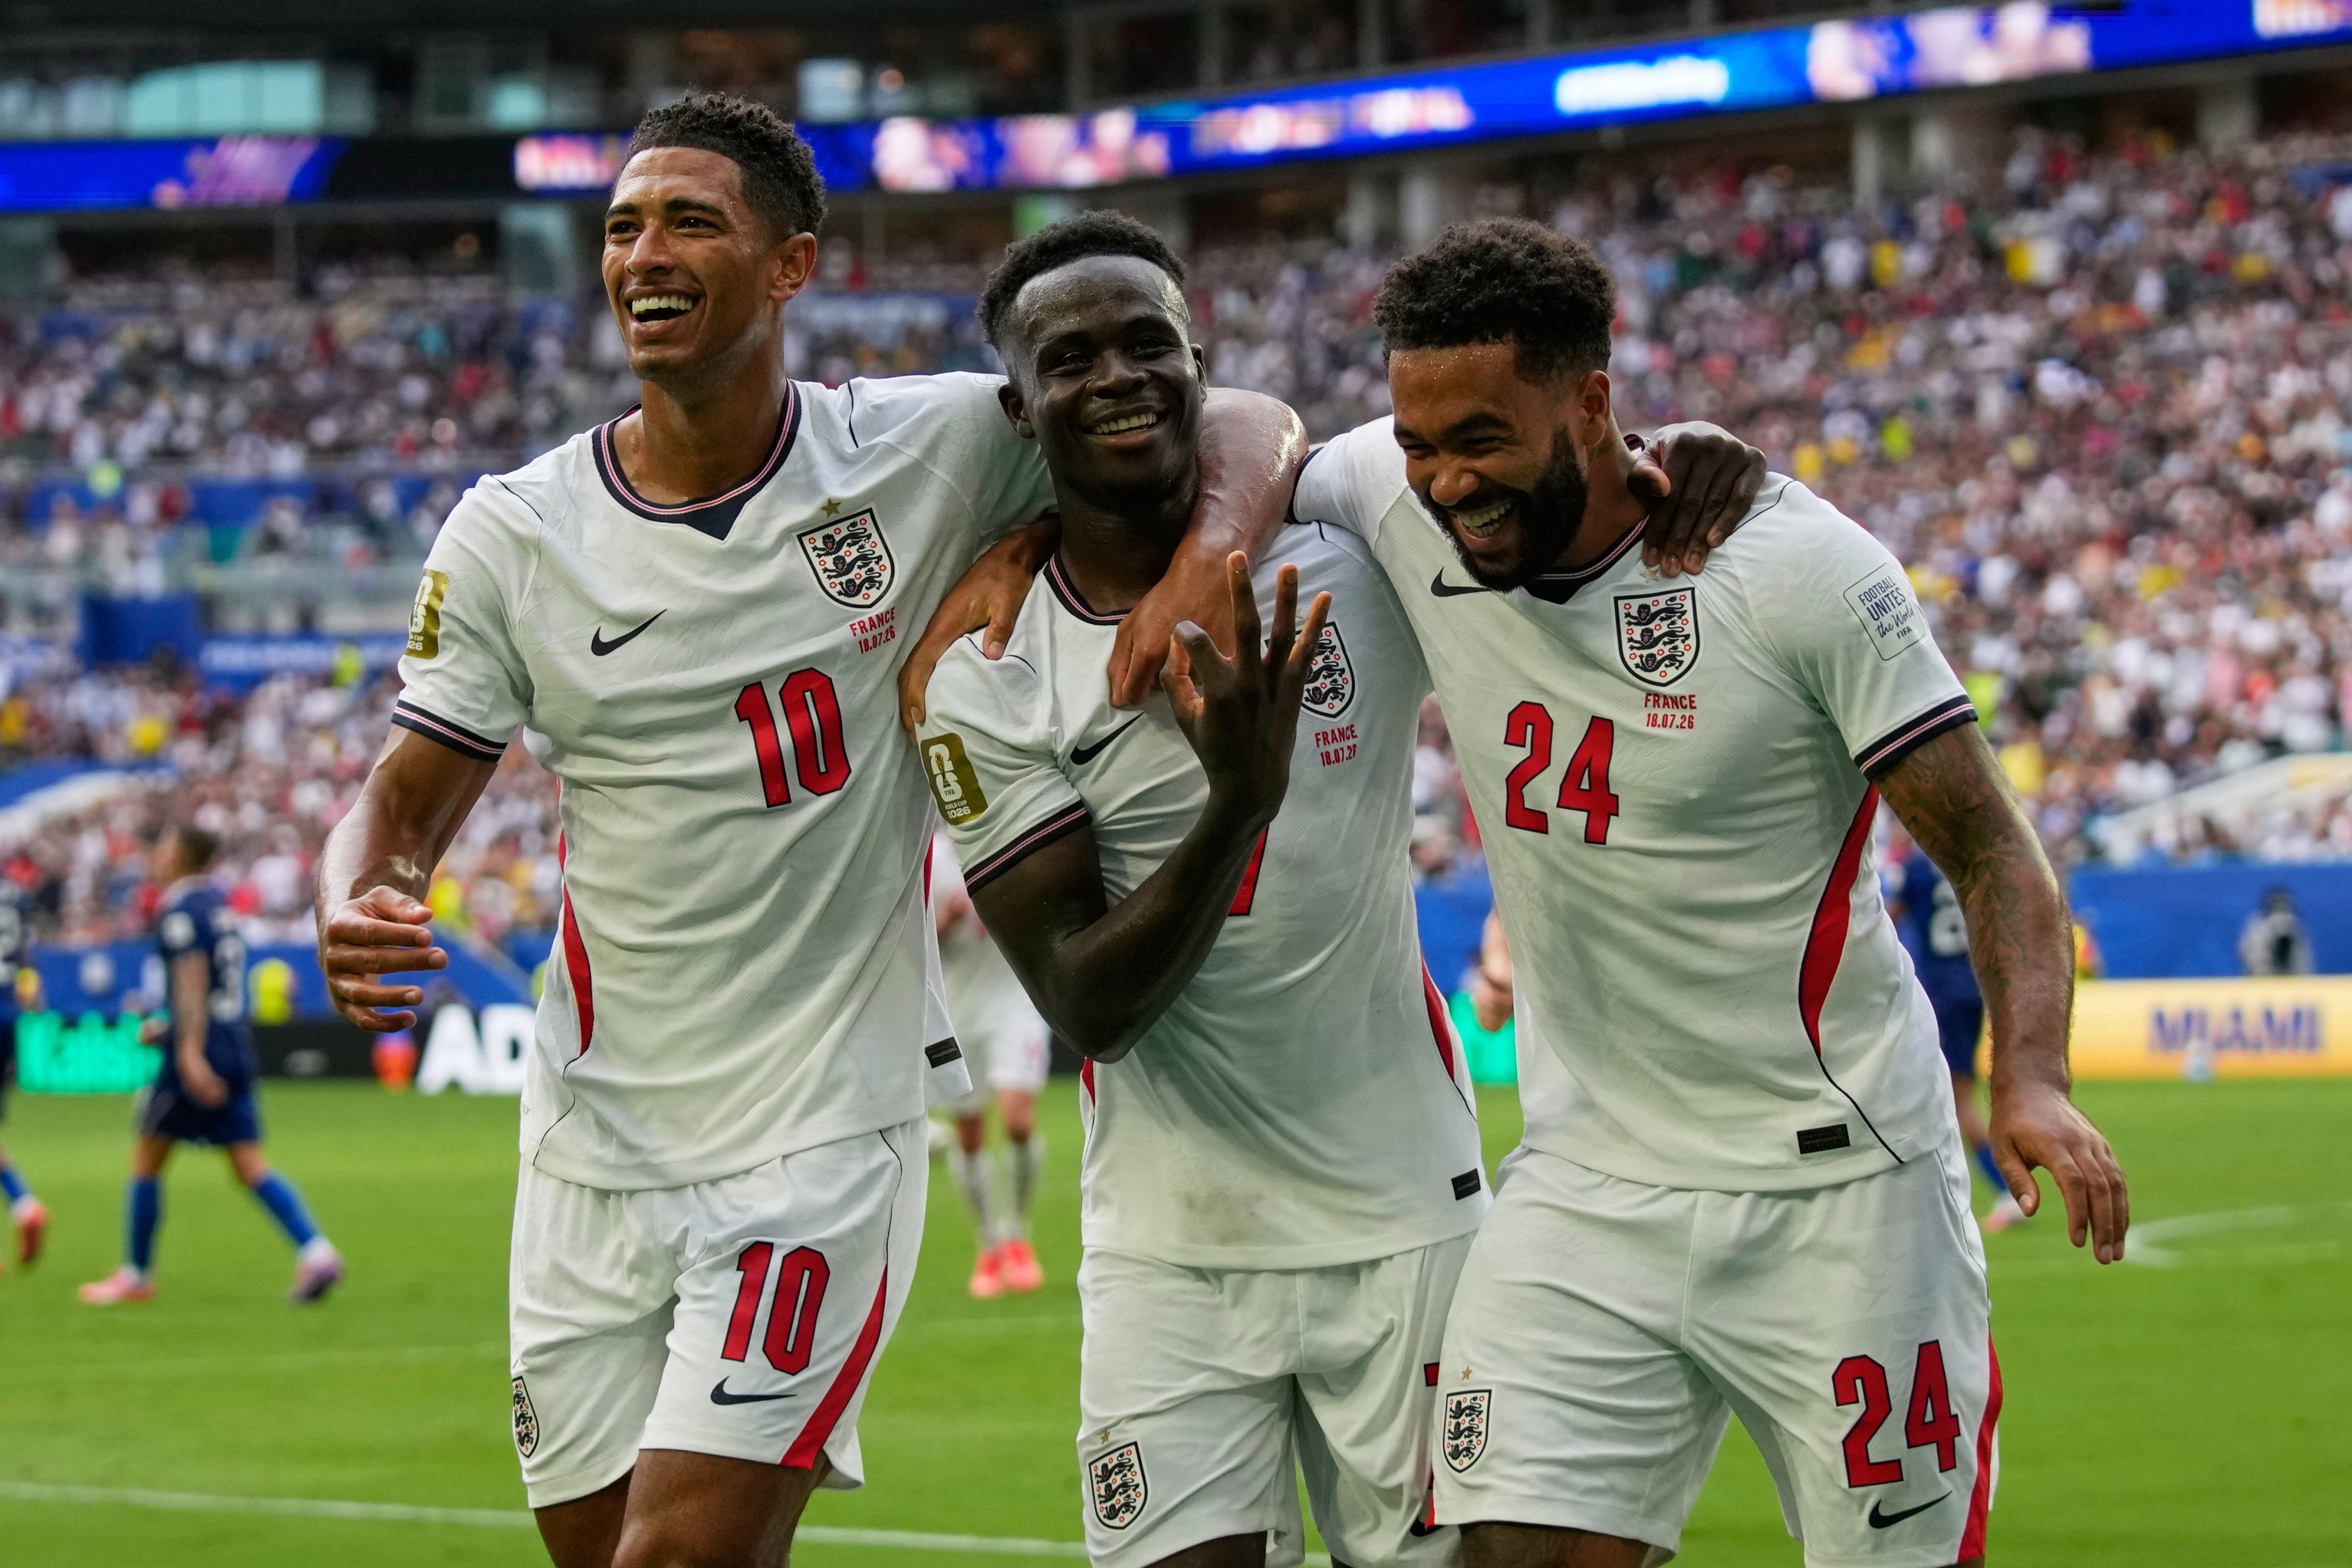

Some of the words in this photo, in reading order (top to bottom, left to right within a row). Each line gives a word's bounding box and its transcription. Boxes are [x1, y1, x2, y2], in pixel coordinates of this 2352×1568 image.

[1858, 576, 1897, 606] FOOTBALL
[1866, 587, 1906, 621] UNITES
[849, 607, 895, 636] FRANCE
[1875, 621, 1894, 638] the
[1891, 603, 1916, 627] World
[1896, 625, 1912, 639] FIFA
[407, 640, 423, 651] 26
[858, 625, 896, 654] 18.07.26
[1644, 693, 1697, 709] FRANCE
[1646, 713, 1694, 729] 18.07.26
[734, 667, 852, 808] 10
[1315, 724, 1358, 748] FRANCE
[1504, 701, 1620, 845] 24
[947, 806, 971, 819] 2026
[2150, 1006, 2322, 1052] MIAMI
[721, 1241, 831, 1376] 10
[1832, 1339, 1961, 1488] 24
